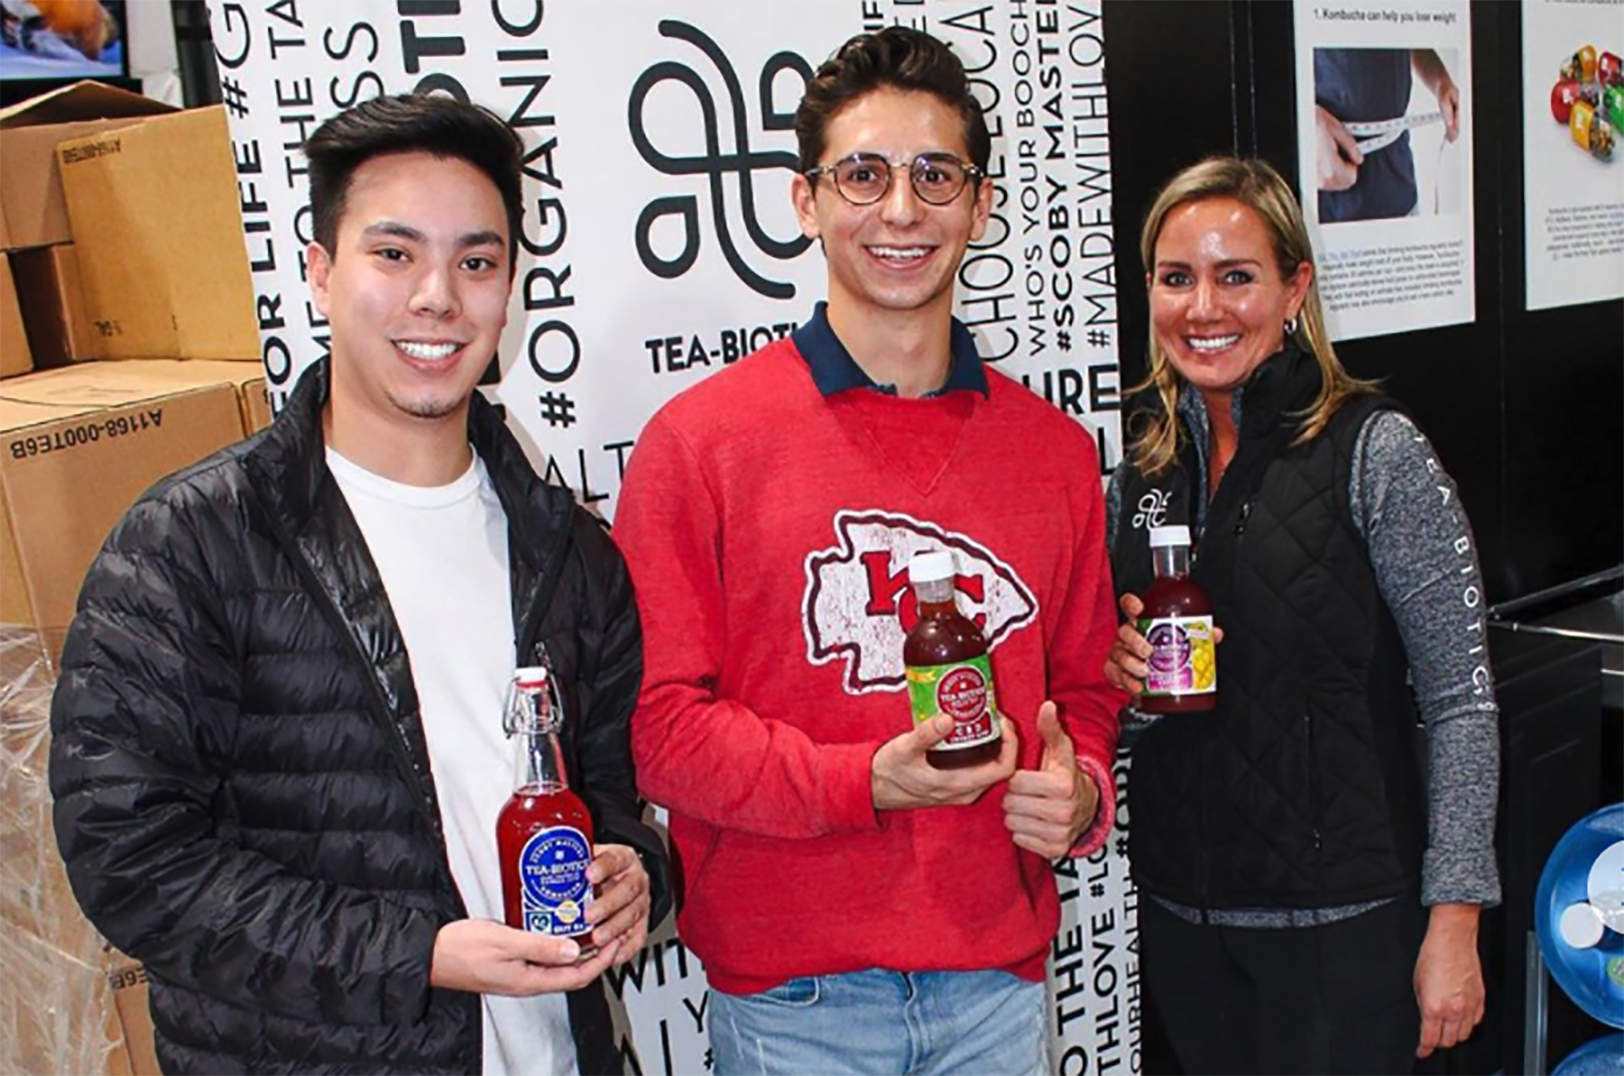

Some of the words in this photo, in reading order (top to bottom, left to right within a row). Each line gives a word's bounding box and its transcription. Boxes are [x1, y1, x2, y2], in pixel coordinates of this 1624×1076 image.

[1010, 0, 1037, 128] BOOCH
[1323, 8, 1365, 21] Kombucha
[1367, 11, 1380, 21] can
[275, 77, 317, 188] THE
[1035, 0, 1066, 161] MASTE
[232, 139, 276, 272] LIFE
[490, 0, 581, 428] #ORGANIC
[1018, 140, 1040, 235] YOUR
[1024, 244, 1047, 357] WHO'S
[1045, 174, 1075, 352] #SCOBY
[10, 407, 164, 460] A1168-000TE6B
[1053, 924, 1086, 1037] THE
